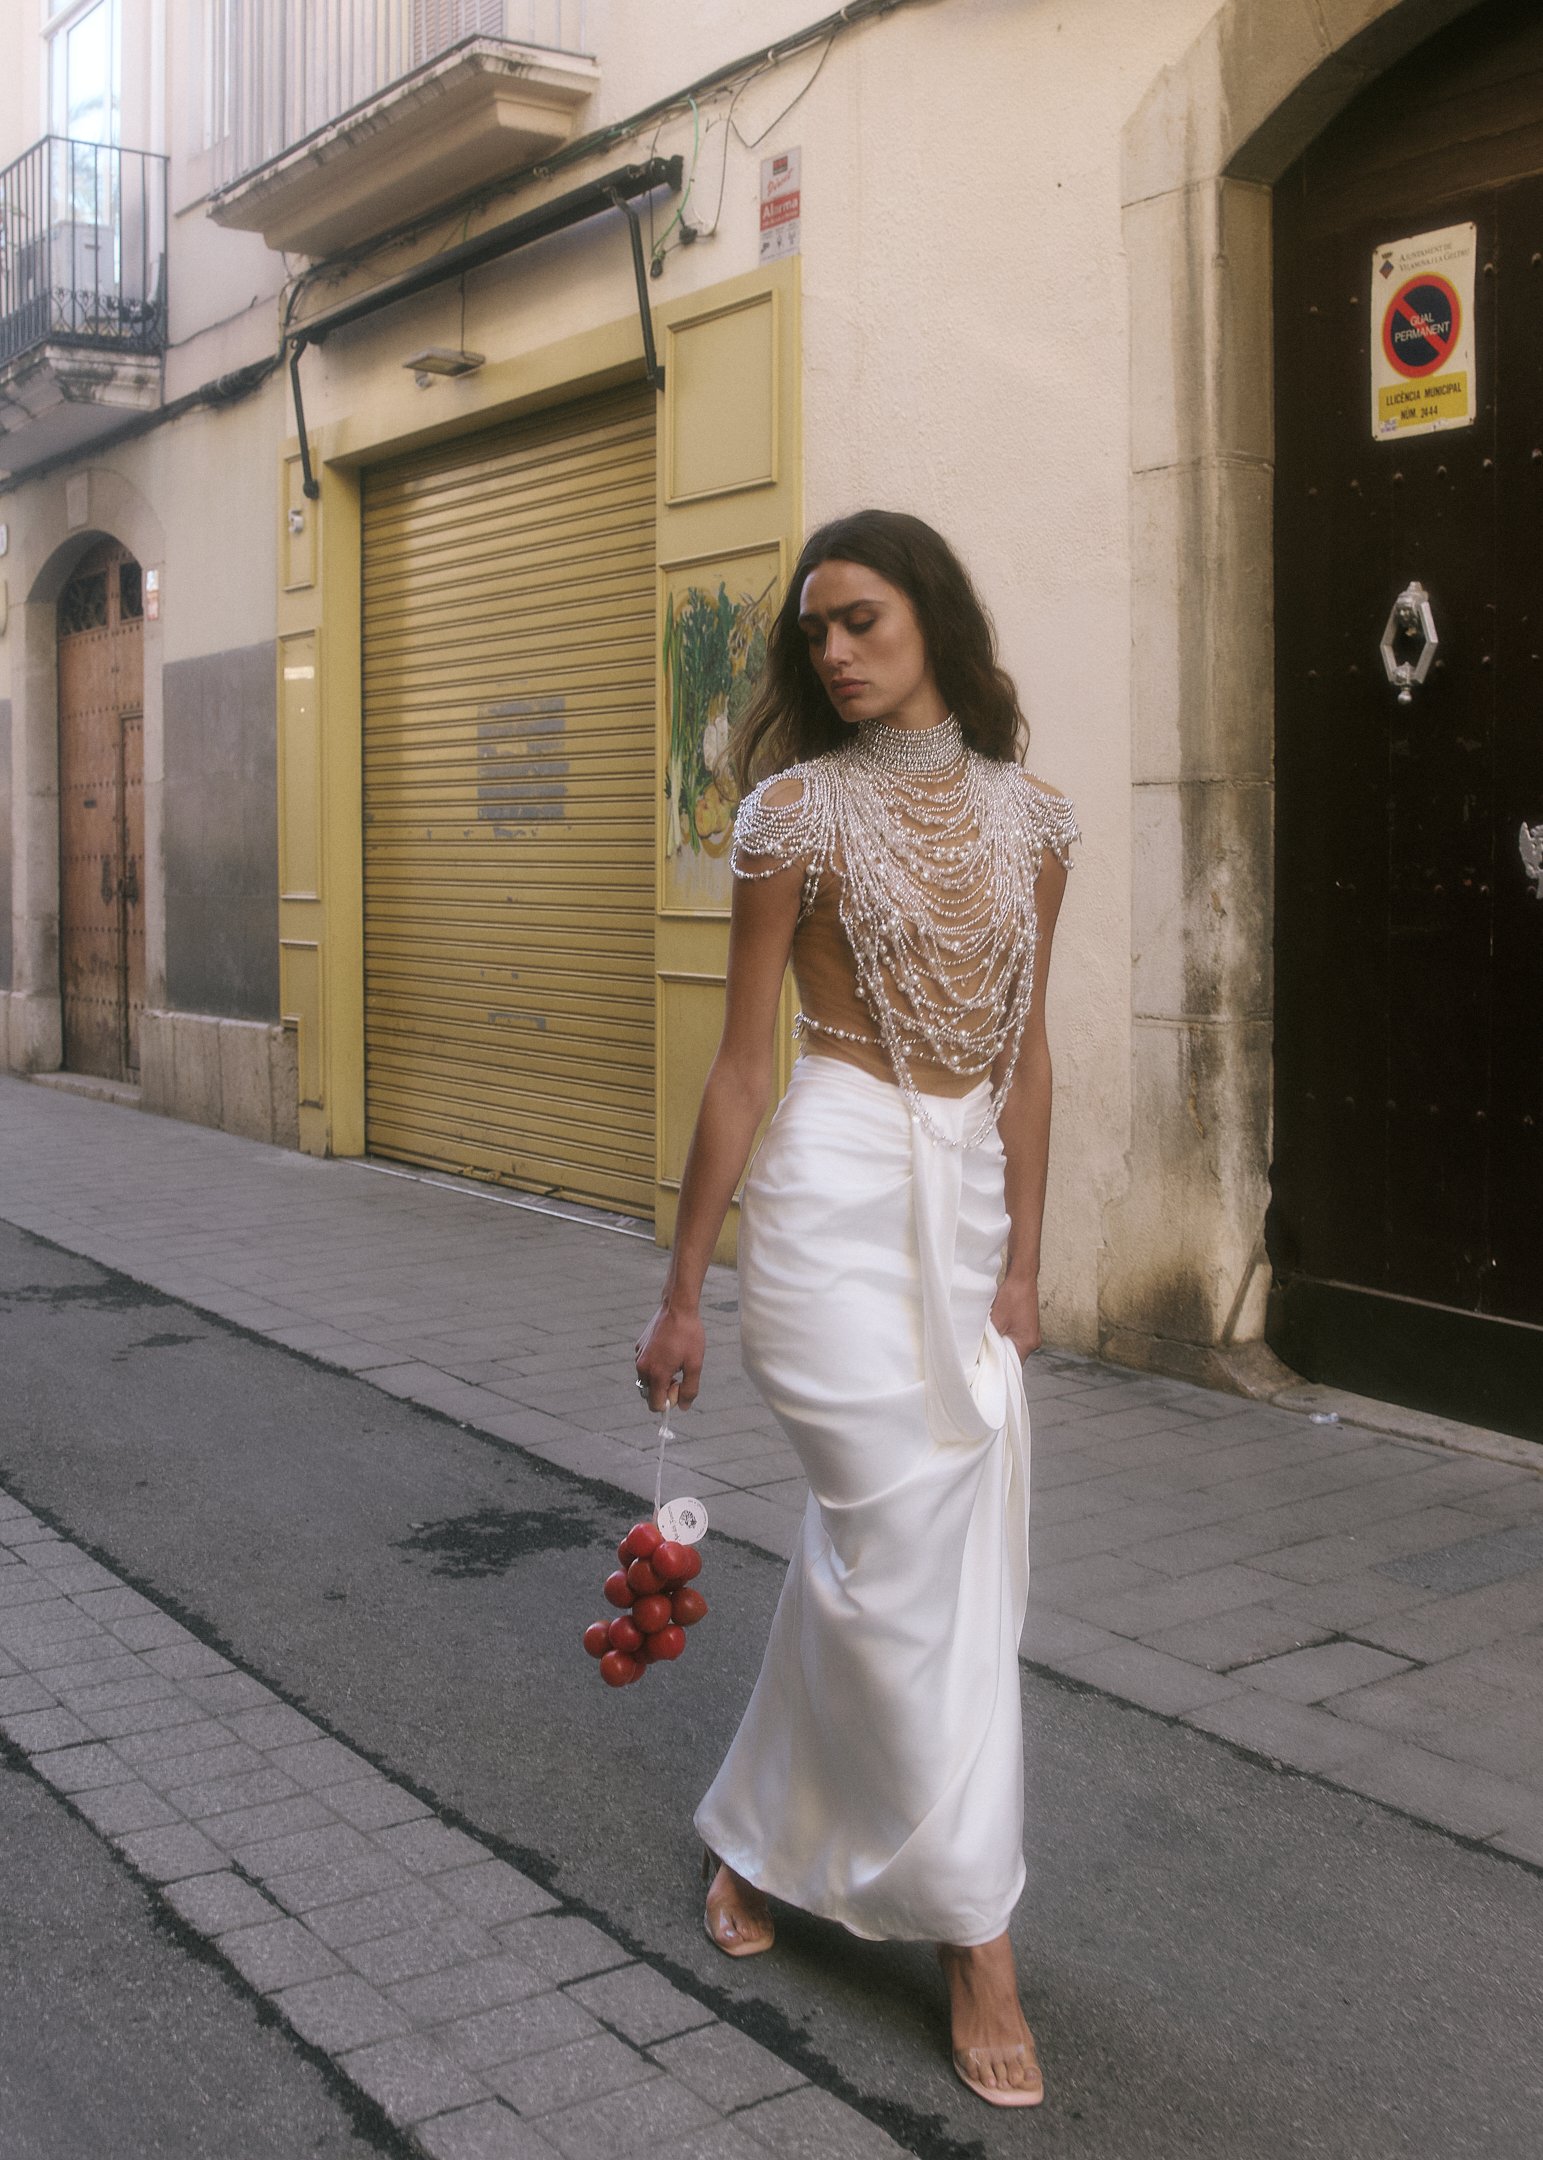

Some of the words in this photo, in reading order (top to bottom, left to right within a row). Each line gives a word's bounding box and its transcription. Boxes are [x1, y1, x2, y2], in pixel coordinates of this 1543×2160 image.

[762, 198, 798, 220] Alarma
[1410, 312, 1434, 326] GUAL
[1394, 321, 1450, 342] PERMANENT
[1424, 382, 1462, 398] MUNICIPAL
